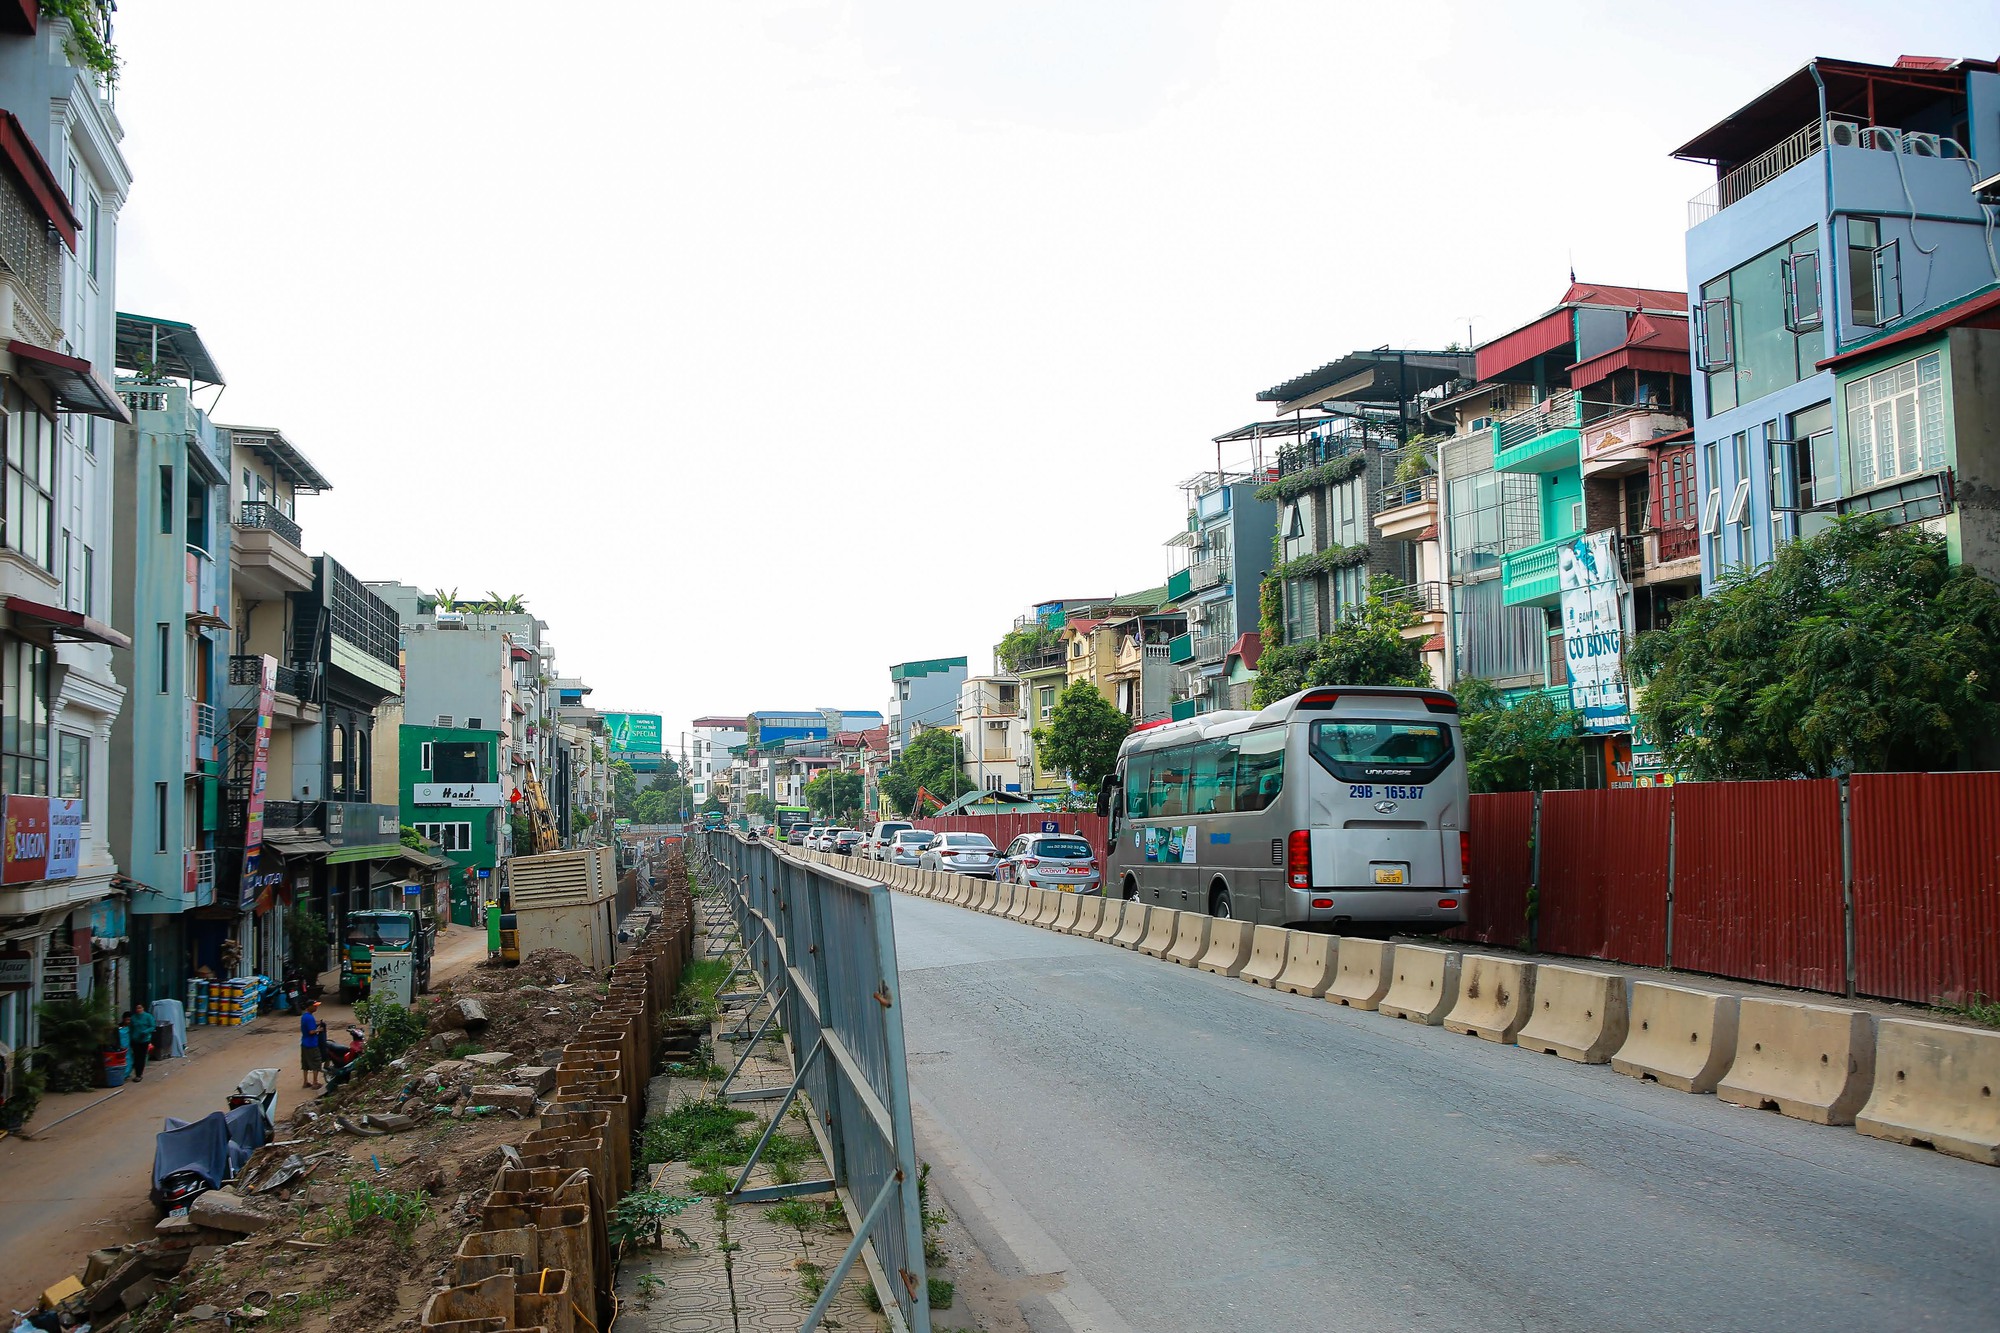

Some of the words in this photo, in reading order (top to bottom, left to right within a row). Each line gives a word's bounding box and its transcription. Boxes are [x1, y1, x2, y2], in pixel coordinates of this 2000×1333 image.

[1569, 628, 1584, 660] CÔ
[1587, 625, 1620, 658] BÔNG
[632, 730, 658, 738] SPECIAL
[443, 784, 475, 799] Handi
[1350, 784, 1373, 799] 29B
[1384, 785, 1424, 800] 165.87
[15, 832, 47, 860] SAIGON
